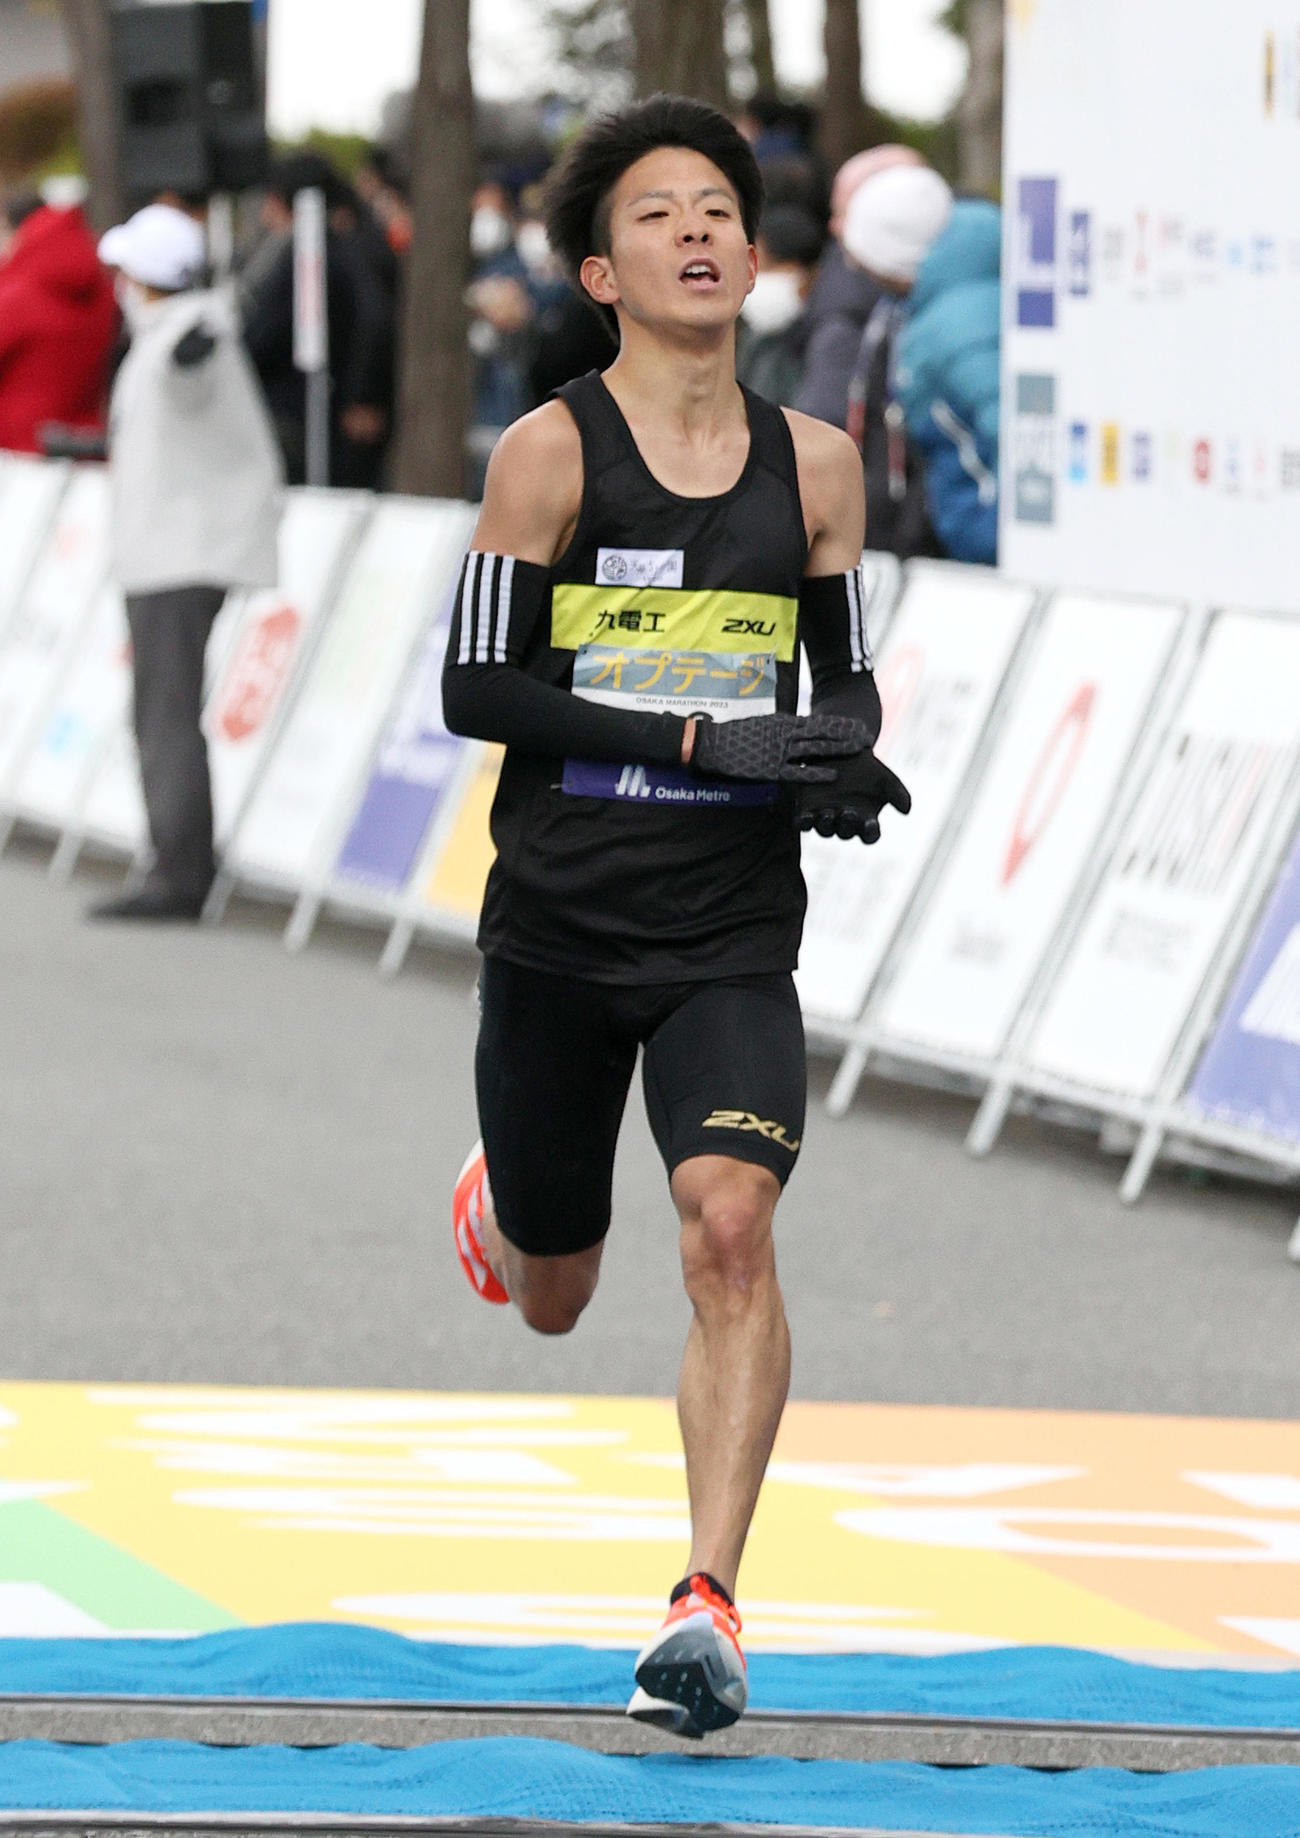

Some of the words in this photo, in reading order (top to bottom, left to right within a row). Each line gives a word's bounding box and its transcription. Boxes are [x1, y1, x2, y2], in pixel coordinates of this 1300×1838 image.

[595, 609, 666, 633] 九電工
[721, 618, 777, 636] 2XU
[589, 651, 765, 697] オプテージ
[635, 696, 664, 706] OSAKA
[665, 698, 708, 708] MARATHON
[654, 785, 695, 801] Osaka
[696, 787, 731, 802] Metro
[702, 1109, 800, 1152] 2XU
